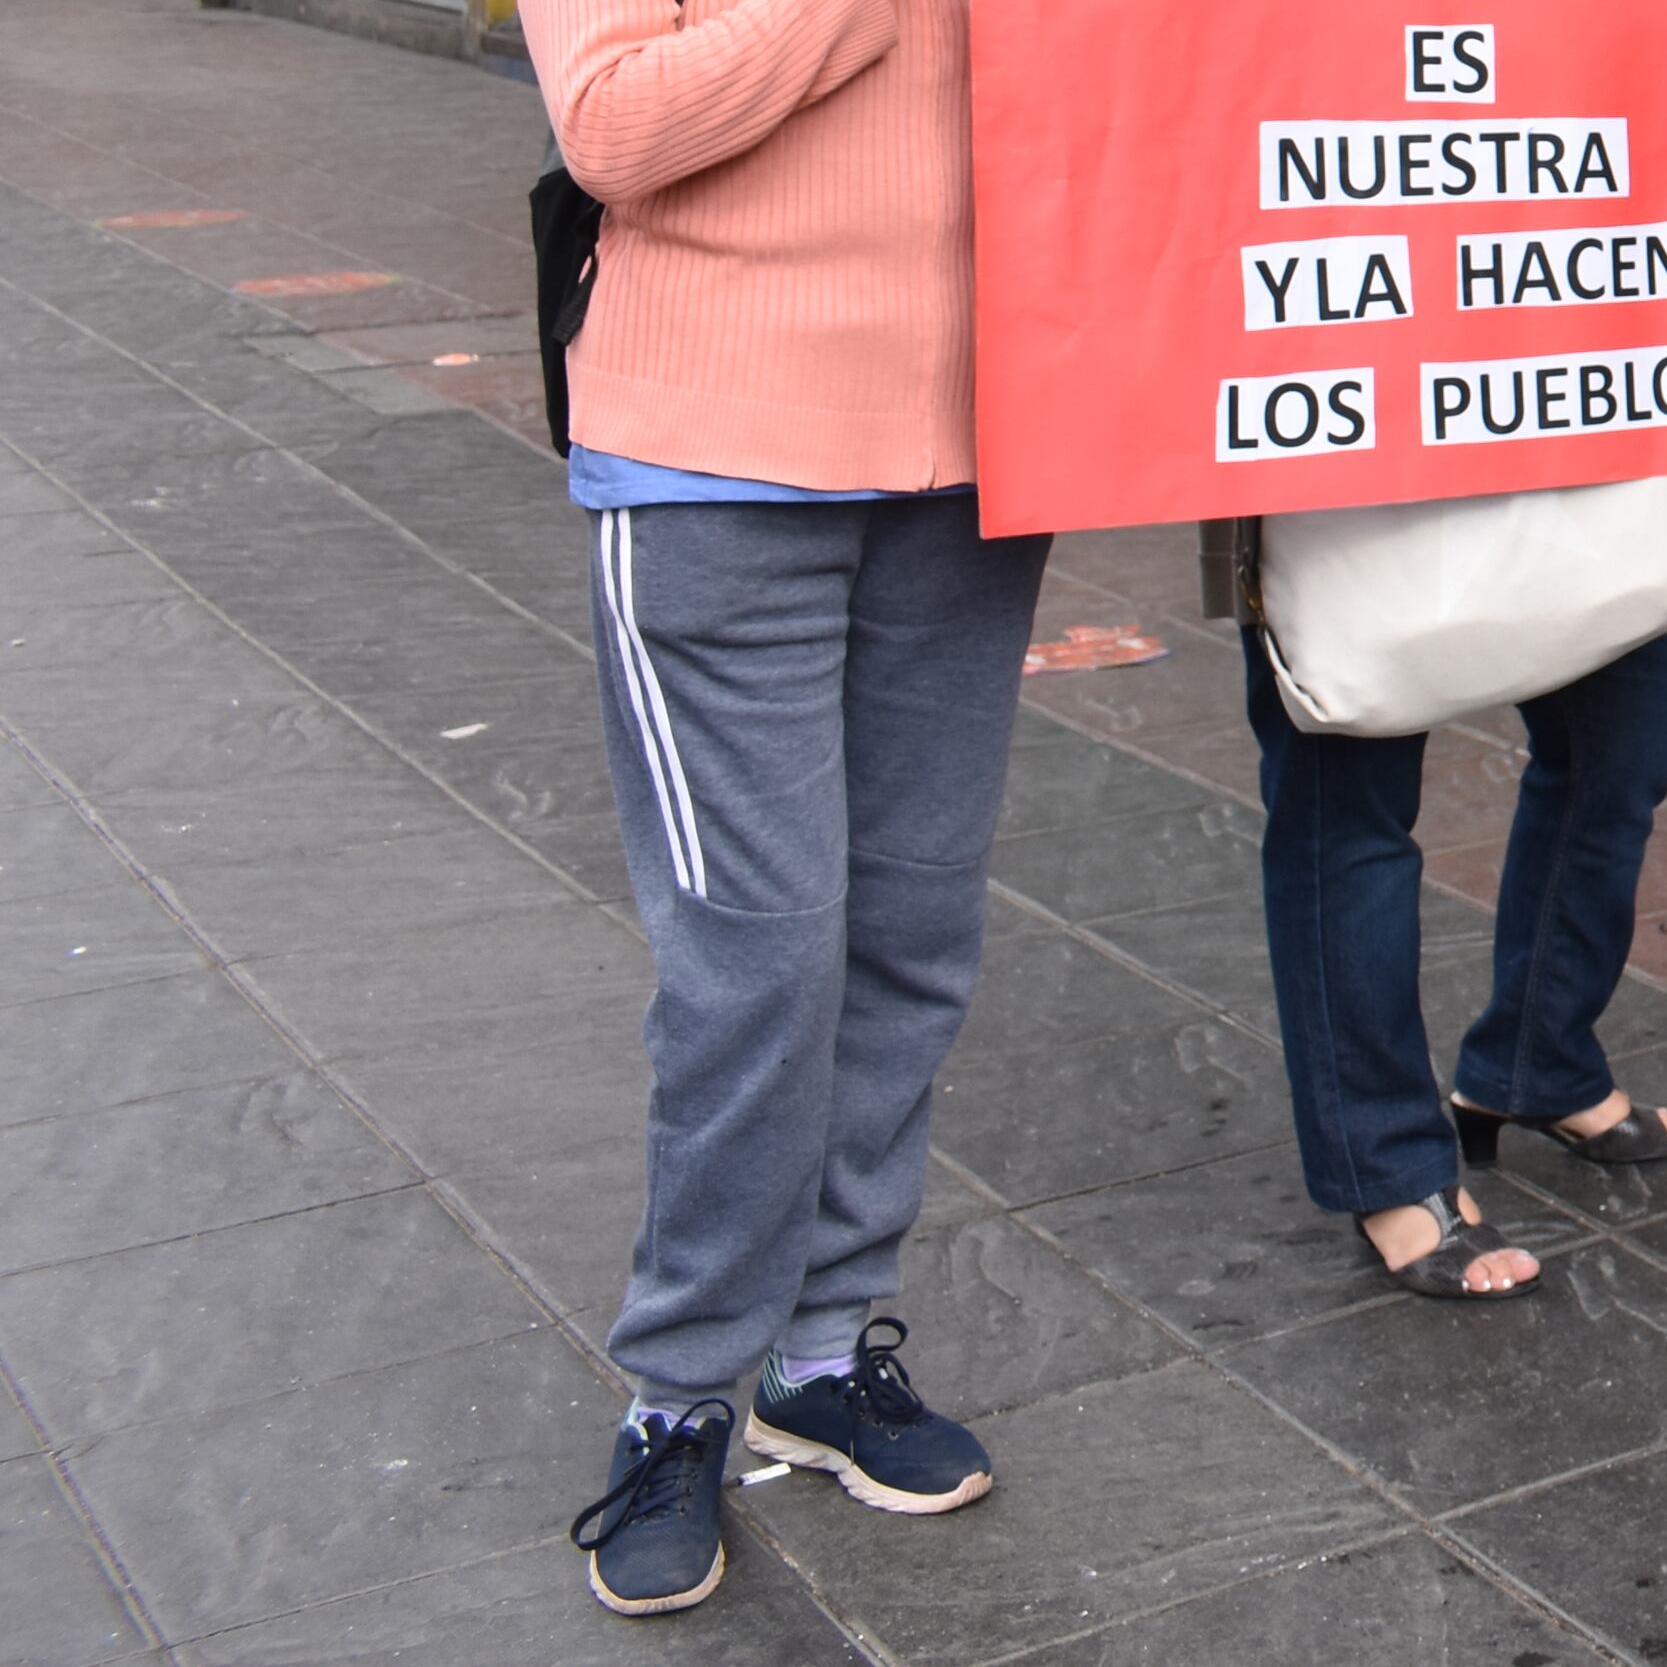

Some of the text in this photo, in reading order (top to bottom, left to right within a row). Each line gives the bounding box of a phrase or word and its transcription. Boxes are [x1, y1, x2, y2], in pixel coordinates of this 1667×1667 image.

[1412, 30, 1490, 94] ES
[1277, 131, 1619, 202] NUESTRA
[1227, 380, 1366, 451] LOS
